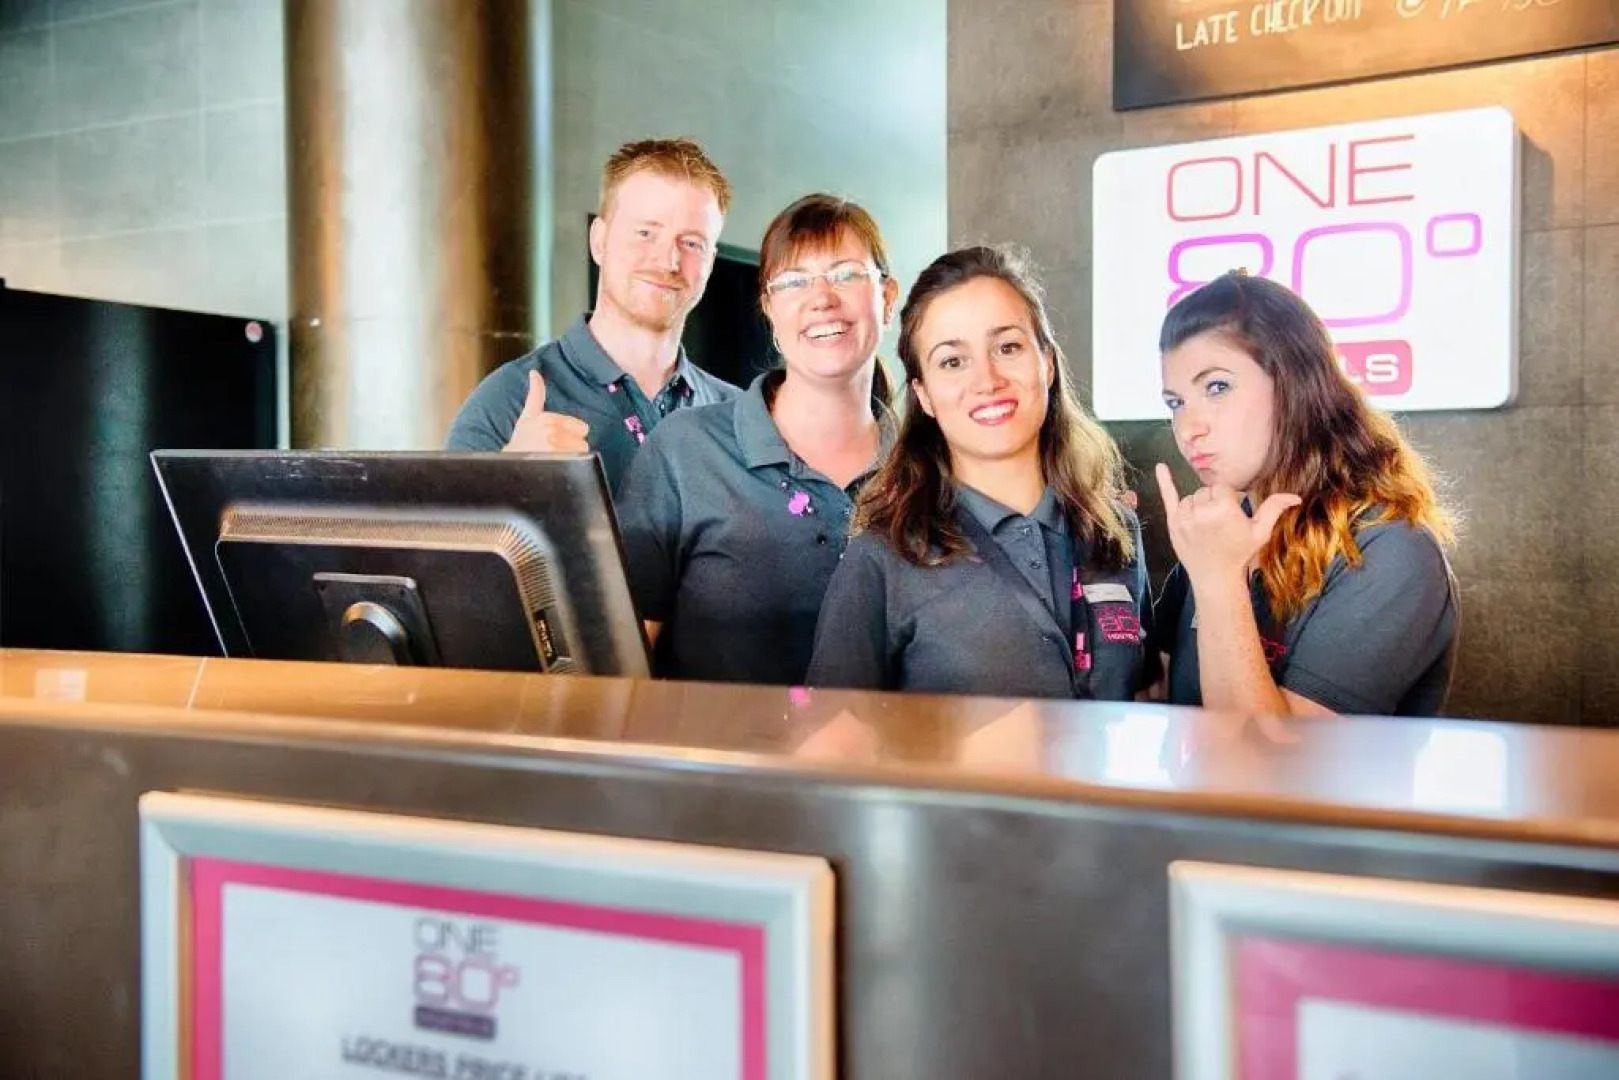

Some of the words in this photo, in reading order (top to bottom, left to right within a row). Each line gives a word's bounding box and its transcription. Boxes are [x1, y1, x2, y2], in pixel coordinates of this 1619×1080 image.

[1175, 11, 1240, 50] LATE
[1167, 134, 1415, 222] ONE
[413, 918, 499, 956] ONE
[341, 1036, 448, 1078] LOCKERS
